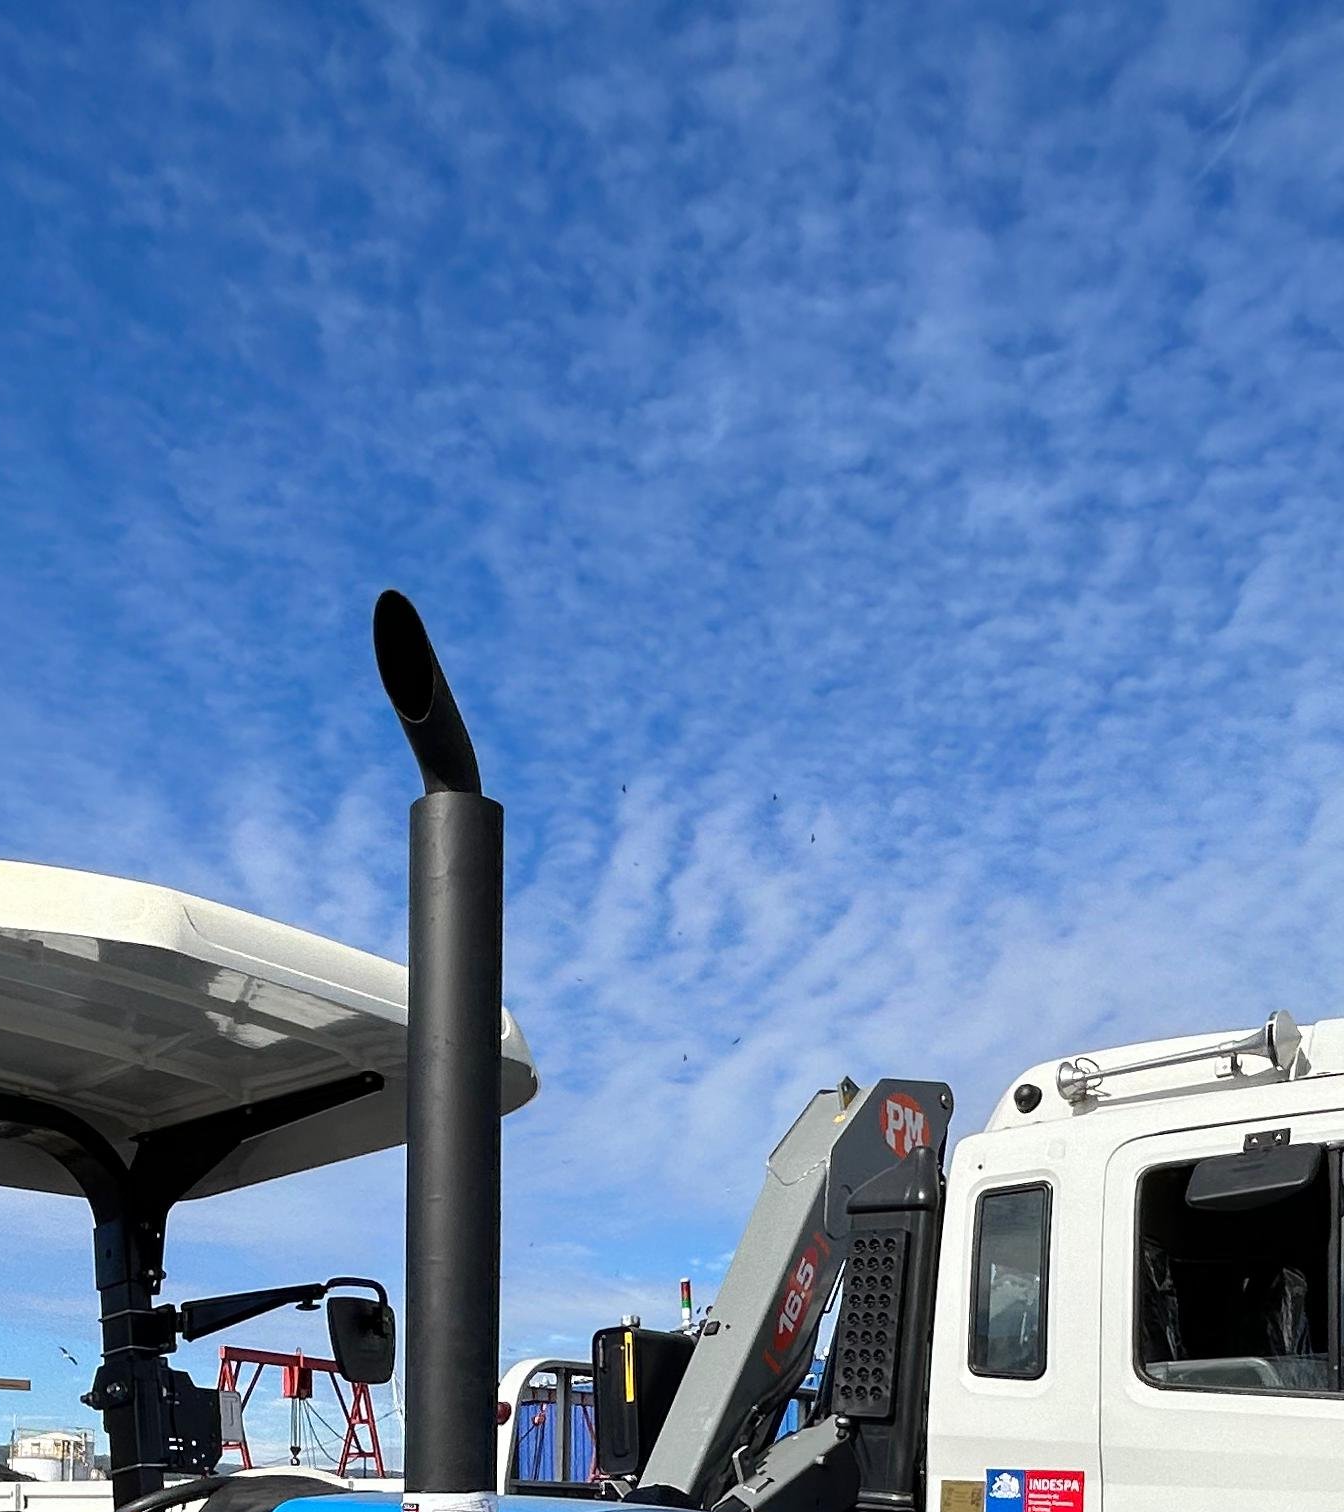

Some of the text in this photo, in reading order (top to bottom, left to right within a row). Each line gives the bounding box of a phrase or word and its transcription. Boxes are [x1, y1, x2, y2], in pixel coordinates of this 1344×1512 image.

[885, 1098, 925, 1151] PM
[778, 1257, 814, 1334] 16.5
[1029, 1478, 1080, 1492] INDESPA
